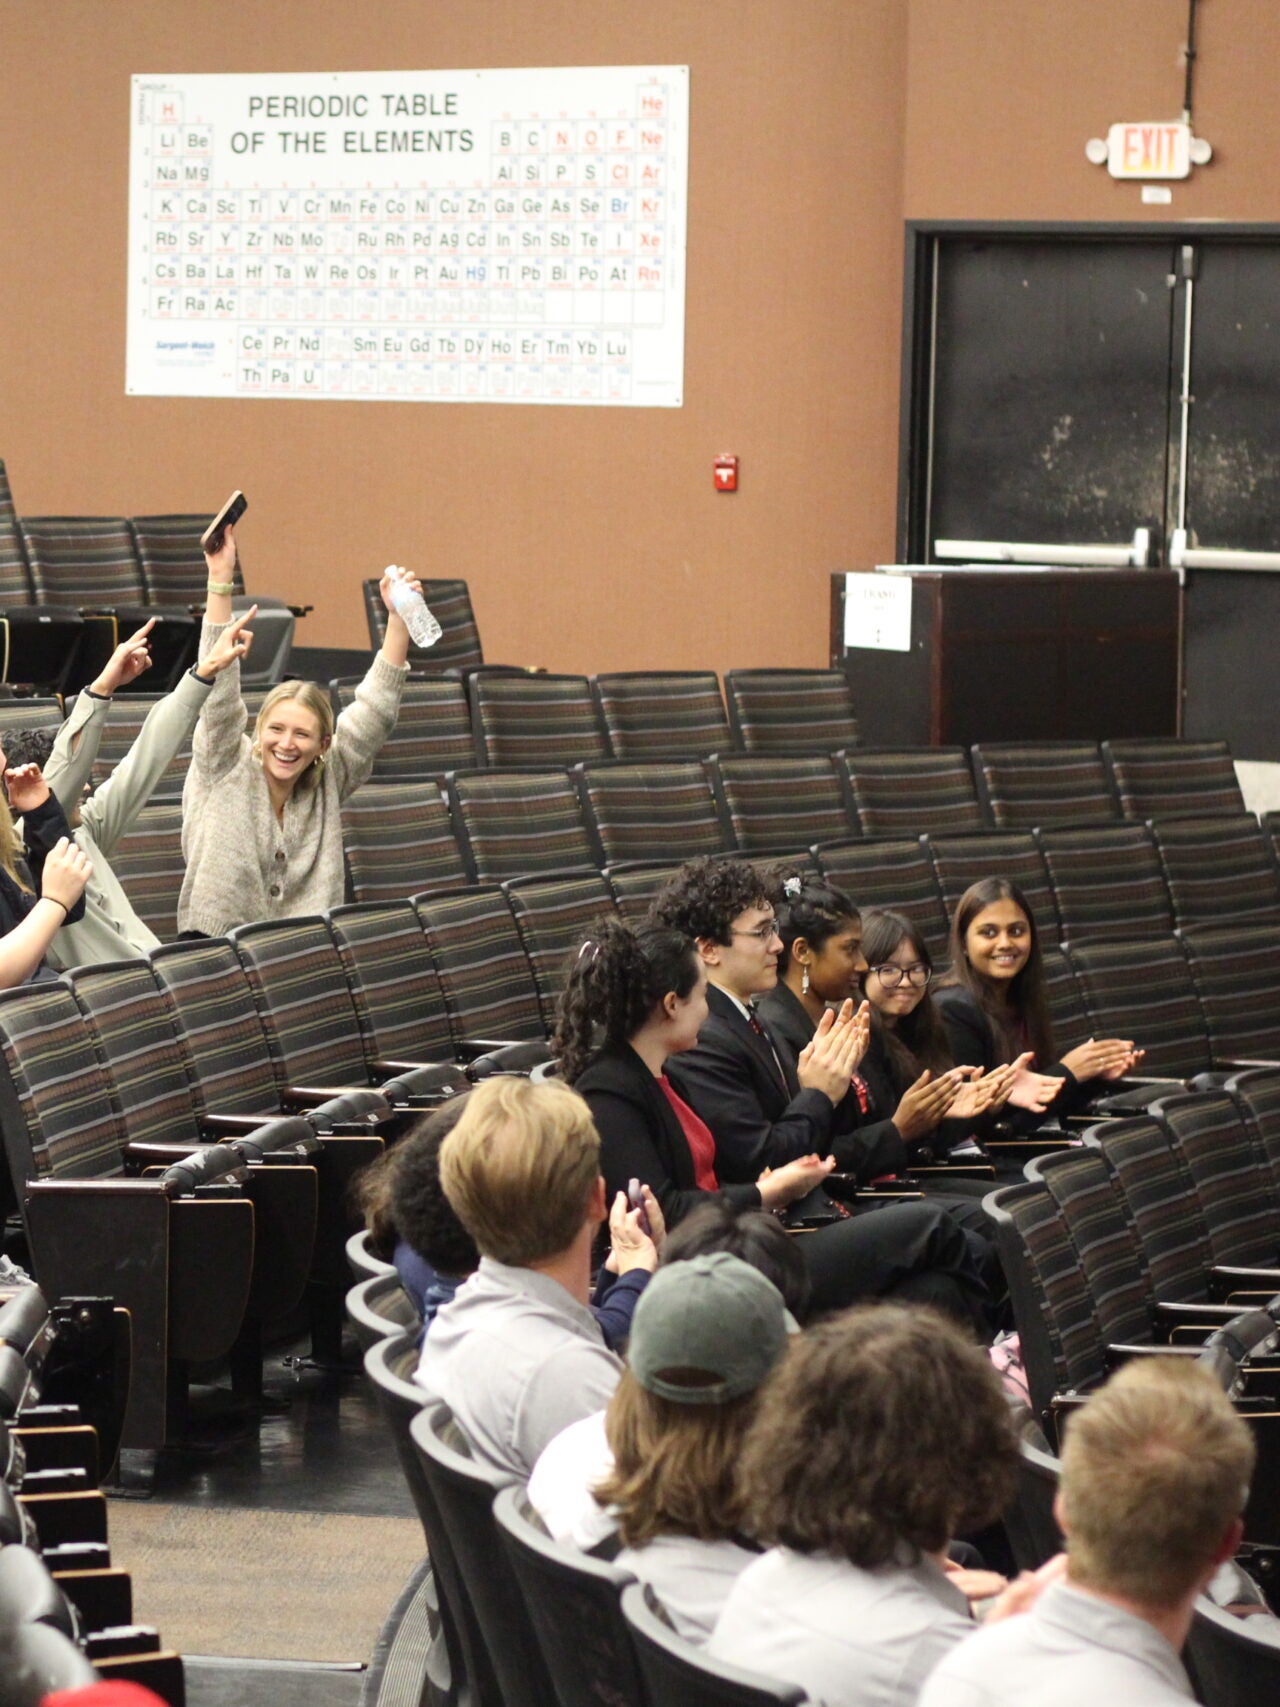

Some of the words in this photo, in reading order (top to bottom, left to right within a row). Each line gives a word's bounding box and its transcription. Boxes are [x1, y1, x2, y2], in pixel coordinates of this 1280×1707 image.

[163, 102, 174, 115] H
[248, 94, 368, 117] PERIODIC
[382, 93, 458, 116] TABLE
[642, 96, 663, 110] He
[161, 134, 174, 147] Li
[188, 135, 208, 147] Be
[231, 132, 265, 154] OF
[278, 132, 326, 153] THE
[344, 129, 474, 153] ELEMENTS
[501, 132, 512, 146] B
[528, 131, 539, 146] C
[557, 131, 568, 145] N
[585, 131, 597, 145] O
[617, 130, 625, 144] F
[641, 131, 662, 144] Ne
[1123, 128, 1178, 172] EXIT
[157, 166, 178, 180] Na
[185, 166, 209, 182] Mg
[526, 165, 540, 180] Si
[557, 165, 566, 179] P
[585, 164, 596, 180] S
[612, 164, 628, 180] Cl
[641, 164, 660, 180] Ar
[162, 200, 172, 213] K
[186, 200, 207, 213] Ca
[217, 199, 236, 213] Sc
[249, 200, 262, 213] Ti
[280, 200, 289, 213] V
[304, 200, 321, 213] Cr
[330, 200, 351, 213] Mn
[360, 200, 377, 213] Fe
[385, 199, 405, 213] Co
[416, 200, 430, 212] Ni
[440, 199, 458, 213] Cu
[468, 200, 485, 213] Zn
[494, 198, 514, 213] Ga
[522, 198, 542, 213] Ge
[551, 200, 570, 213] As
[580, 198, 599, 213] Se
[611, 198, 629, 212] Br
[642, 199, 658, 212] Kr
[156, 232, 177, 245] Rb
[188, 232, 205, 246] Sr
[221, 232, 231, 245] Y
[246, 232, 262, 246] Zr
[273, 233, 294, 246] Nb
[301, 233, 323, 246] Mo
[358, 232, 377, 246] Ru
[385, 232, 405, 246] Rh
[413, 233, 431, 246] Pd
[440, 233, 459, 248] Ag
[467, 232, 486, 246] Cd
[497, 233, 510, 246] In
[522, 232, 541, 246] Sn
[550, 232, 570, 246] Sb
[581, 232, 598, 246] Te
[617, 233, 621, 246] I
[640, 233, 660, 246] Xe
[155, 264, 176, 278] Cs
[186, 265, 206, 278] Ba
[216, 265, 234, 278] La
[246, 266, 263, 278] Hf
[275, 266, 291, 278] Ta
[304, 266, 318, 279] W
[330, 266, 348, 279] Re
[357, 266, 376, 279] Os
[389, 267, 399, 279] Ir
[415, 266, 428, 279] Pt
[439, 266, 457, 280] Au
[466, 267, 486, 281] Hg
[522, 266, 540, 280] Pb
[552, 267, 567, 280] Bi
[579, 266, 598, 280] Po
[610, 267, 627, 280] At
[638, 267, 660, 280] Rn
[157, 297, 174, 310] Fr
[186, 297, 205, 311] Ra
[214, 298, 235, 311] Ac
[242, 336, 262, 350] Ce
[273, 336, 289, 350] Pr
[300, 337, 320, 350] Nd
[354, 337, 377, 351] Sm
[383, 338, 402, 351] Eu
[410, 338, 430, 352] Gd
[438, 339, 456, 352] Tb
[464, 339, 484, 355] Dy
[491, 340, 512, 353] Ho
[522, 340, 537, 353] Er
[547, 341, 569, 354] Tm
[578, 341, 596, 355] Yb
[607, 341, 626, 355] Lu
[242, 368, 261, 382] Th
[272, 369, 289, 383] Pa
[304, 370, 314, 383] U
